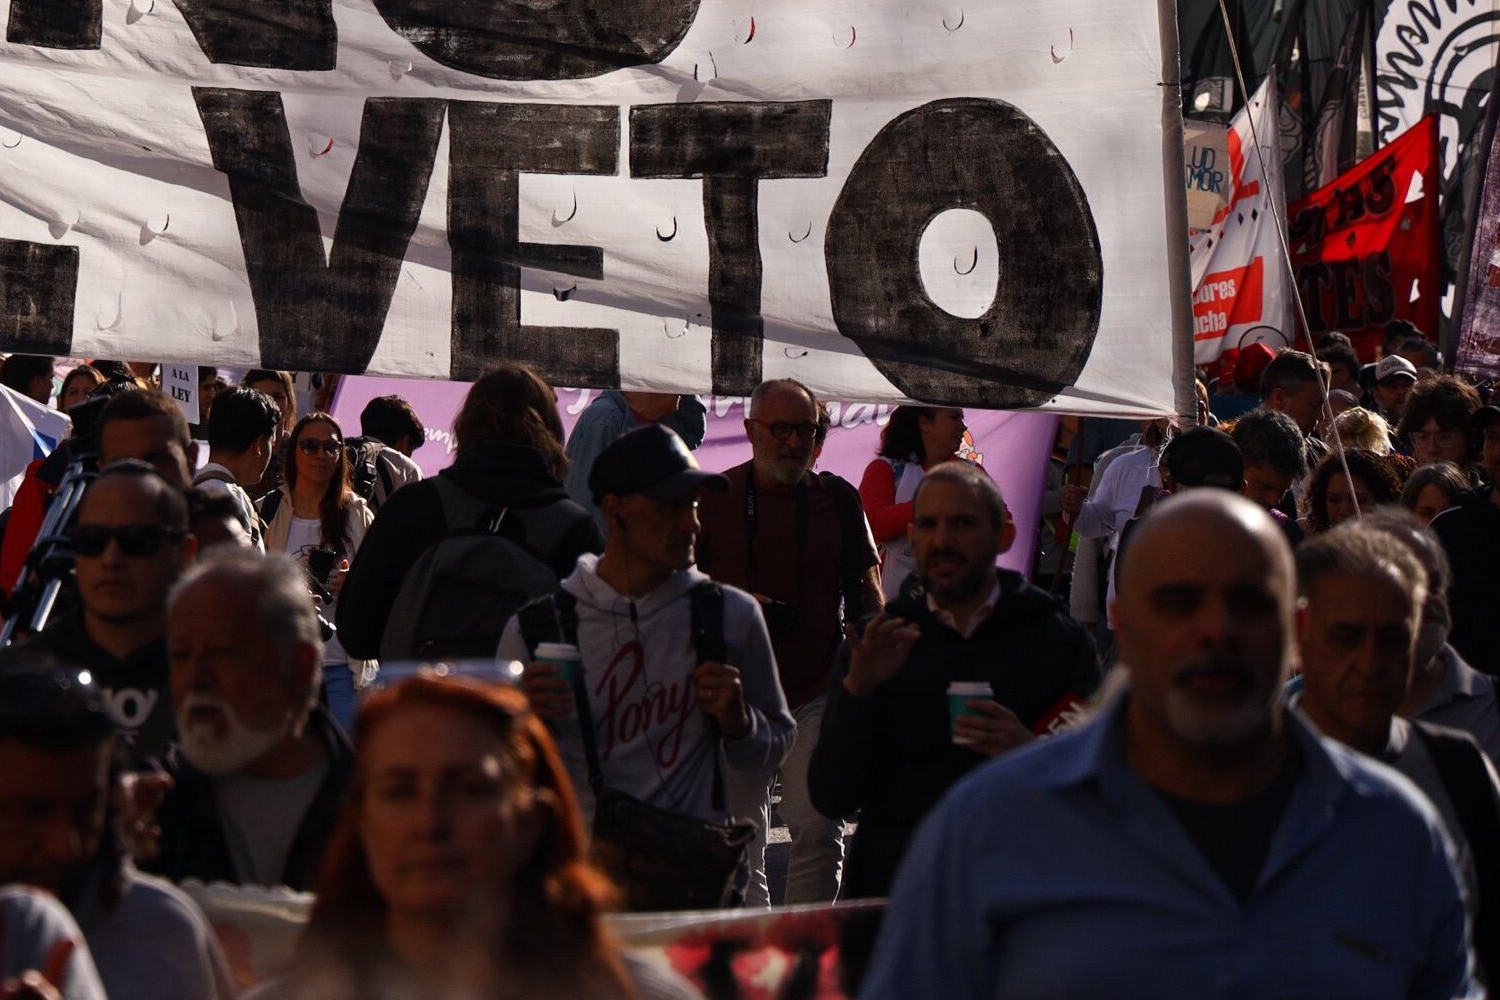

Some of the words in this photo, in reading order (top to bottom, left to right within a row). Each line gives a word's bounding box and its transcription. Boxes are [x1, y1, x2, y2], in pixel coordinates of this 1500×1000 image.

[1192, 146, 1215, 170] UD
[191, 86, 1104, 408] VETO
[1295, 250, 1397, 334] TES
[171, 386, 191, 403] LEY
[172, 368, 177, 378] A
[179, 370, 190, 382] LA
[595, 640, 693, 768] Pony
